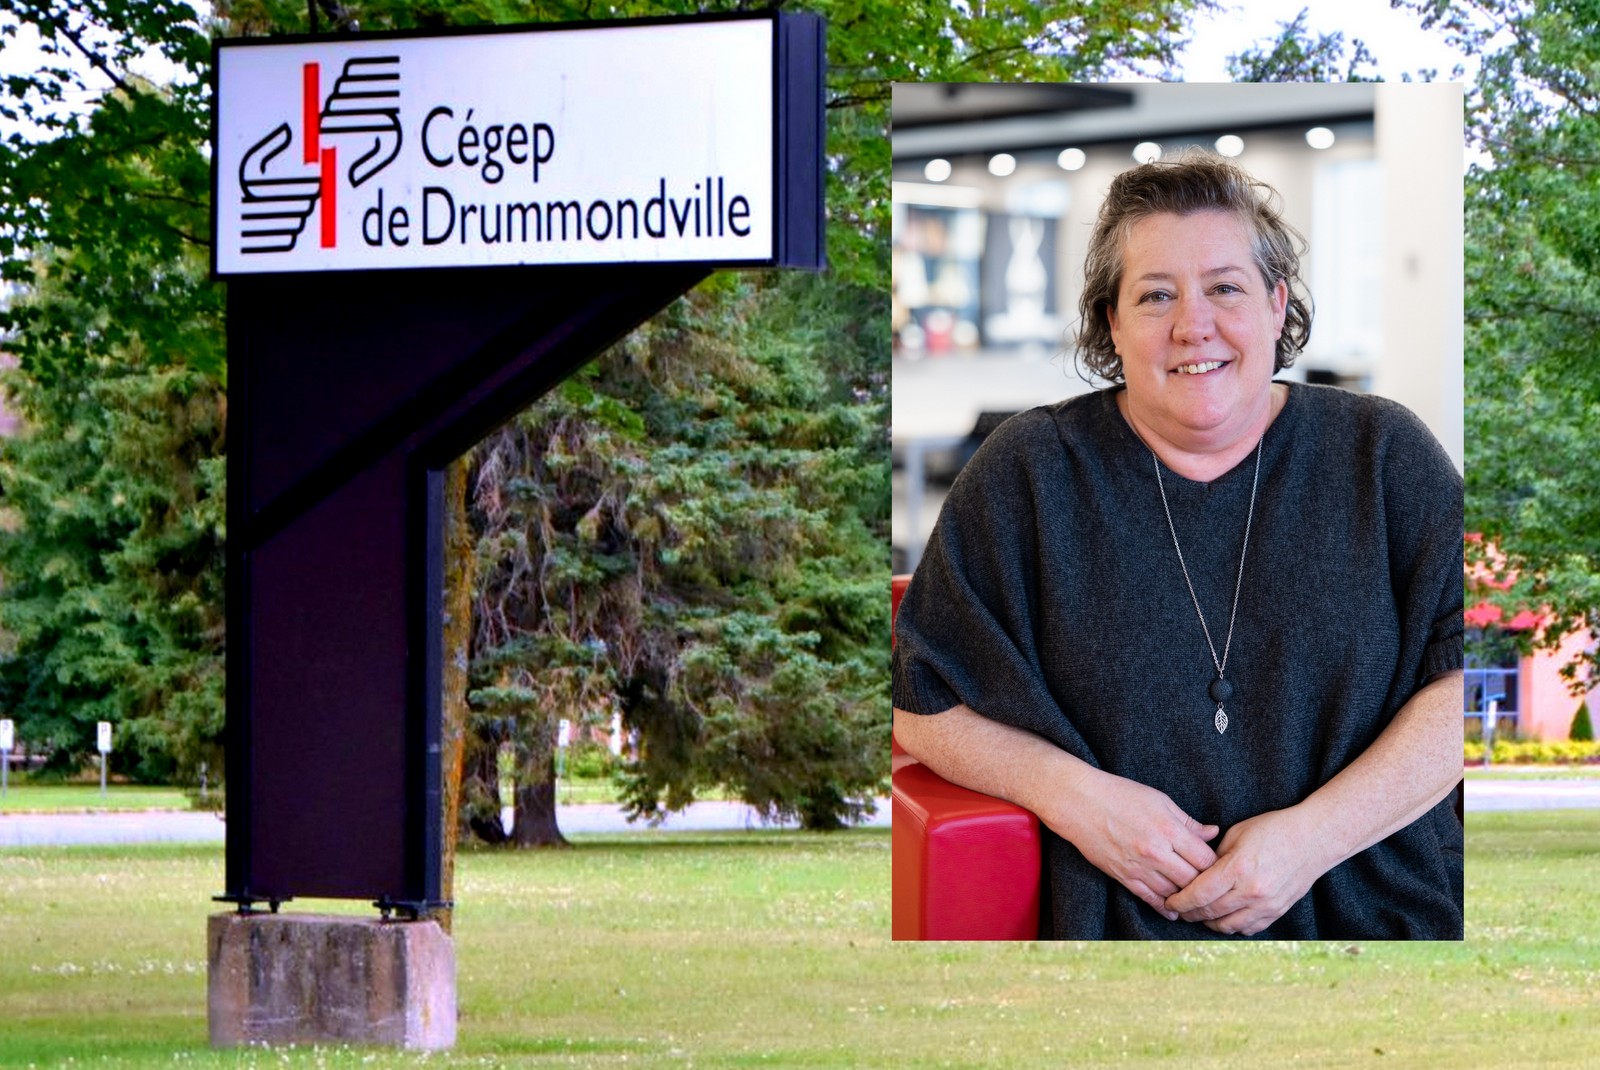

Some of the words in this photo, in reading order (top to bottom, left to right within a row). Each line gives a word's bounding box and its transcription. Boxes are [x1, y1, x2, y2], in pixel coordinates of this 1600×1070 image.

[421, 106, 555, 184] Cégep
[362, 188, 409, 247] de
[422, 176, 751, 246] Drummondville
